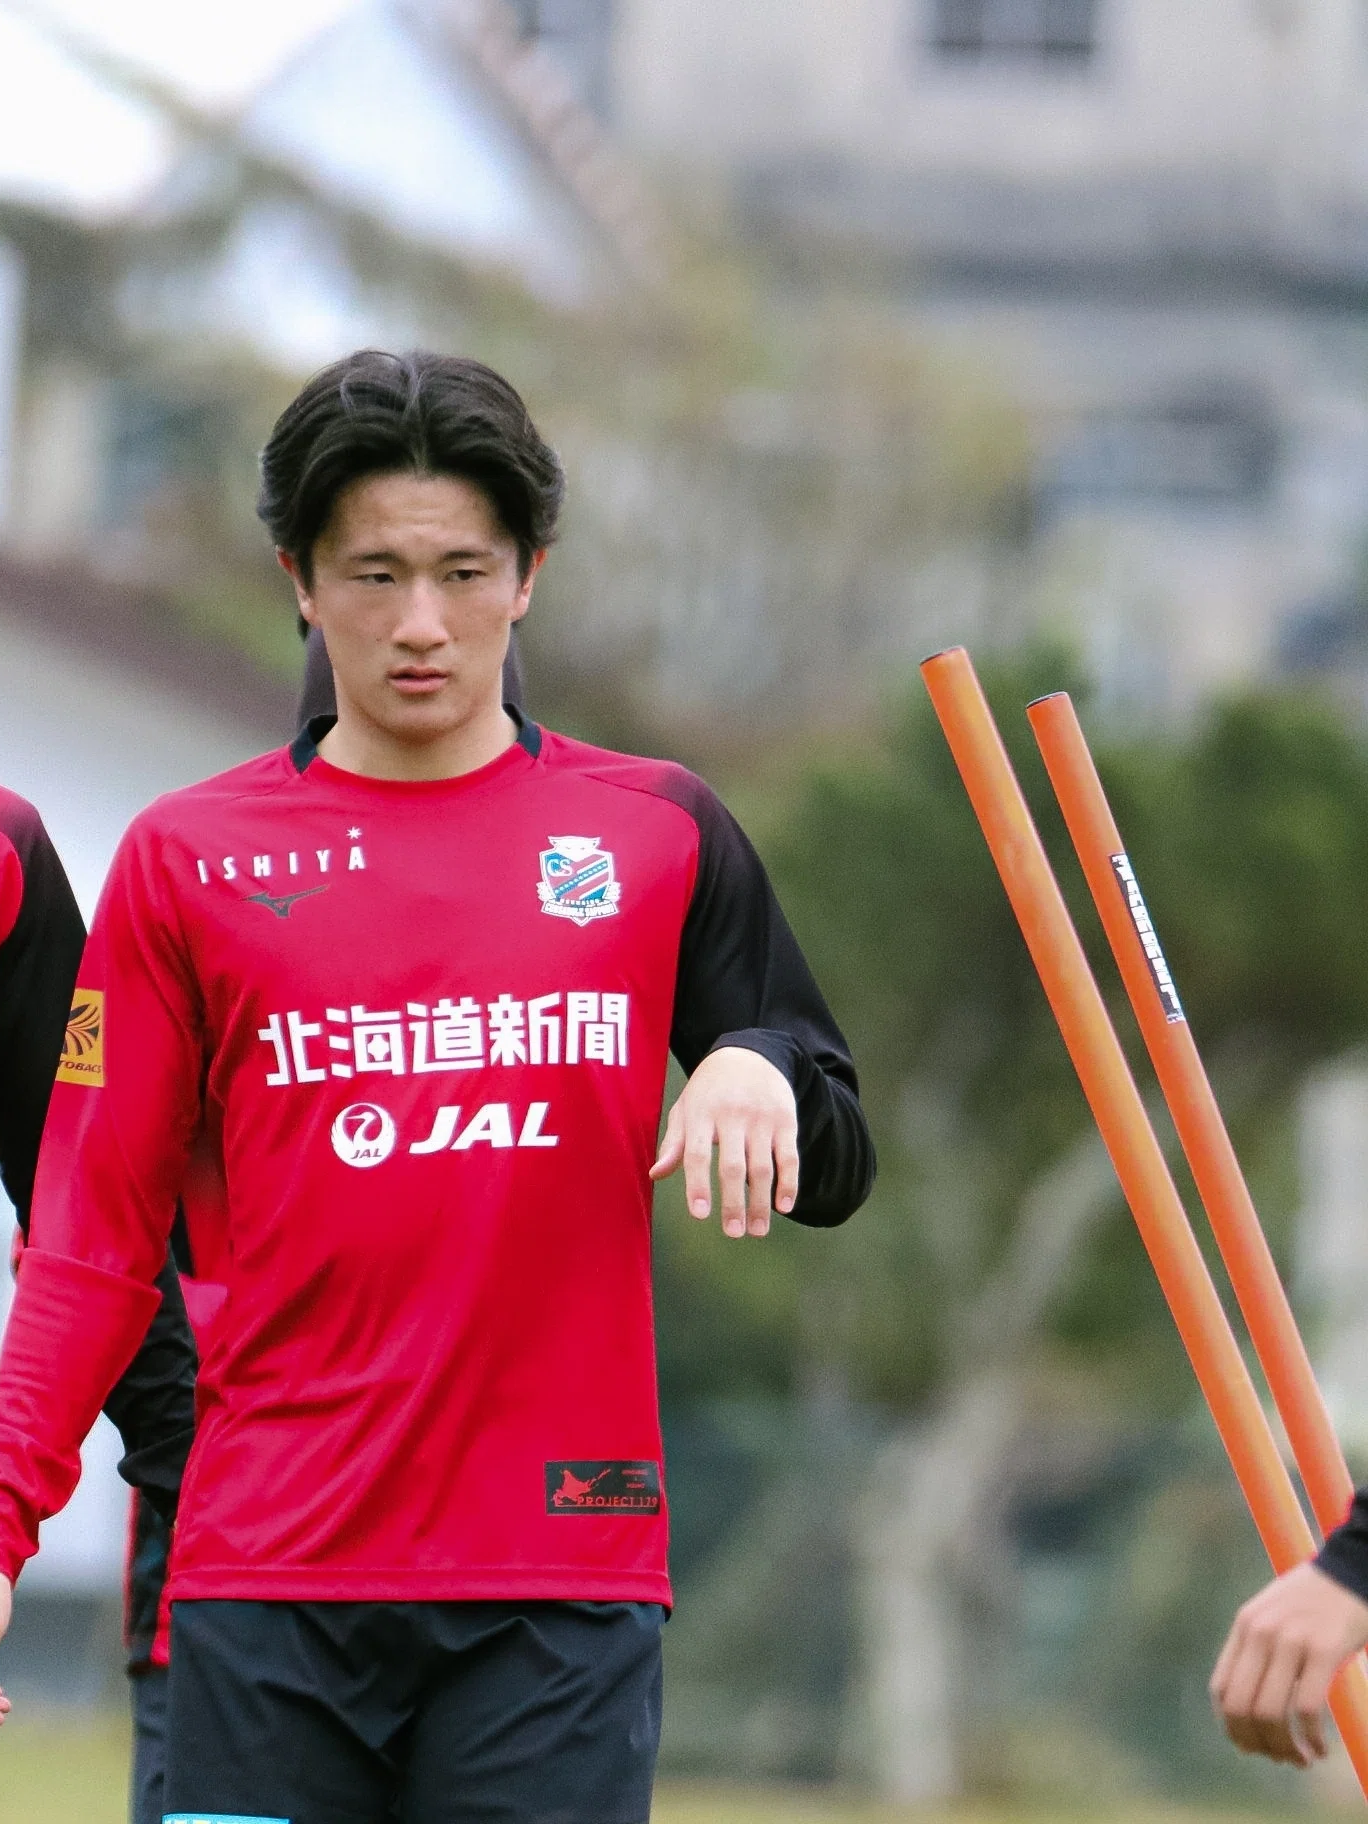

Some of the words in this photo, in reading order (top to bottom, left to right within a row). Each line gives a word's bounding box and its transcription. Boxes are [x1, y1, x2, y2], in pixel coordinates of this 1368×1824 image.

[196, 845, 366, 885] ISHIYA
[547, 858, 573, 877] CS
[257, 991, 629, 1088] 北海道新聞
[408, 1101, 560, 1155] JAL
[350, 1147, 382, 1160] JAL
[576, 1496, 634, 1507] PROJECT
